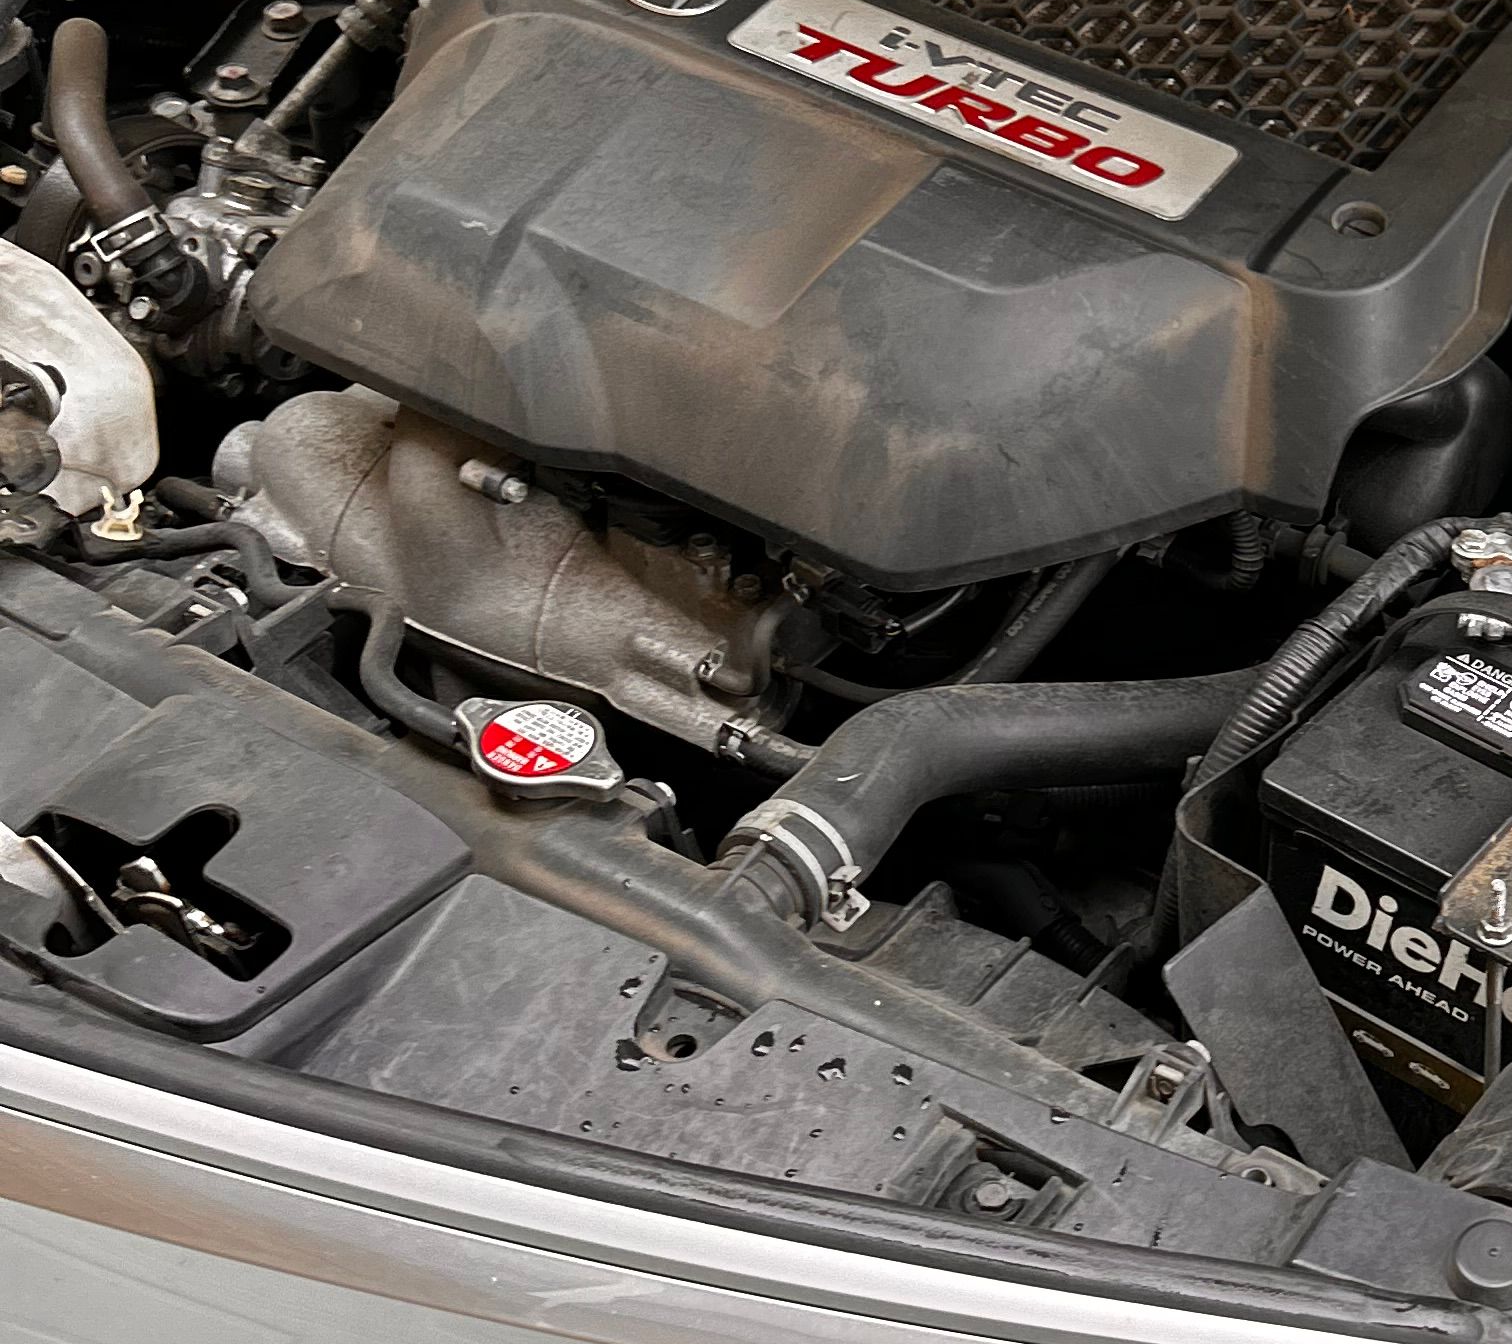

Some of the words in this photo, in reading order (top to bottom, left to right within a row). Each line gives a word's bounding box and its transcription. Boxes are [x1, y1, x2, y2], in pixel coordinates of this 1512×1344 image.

[792, 22, 1165, 190] TURBO
[880, 25, 1123, 134] i-VTEC
[1302, 924, 1382, 976] POWER
[1387, 974, 1471, 1023] AHEAD
